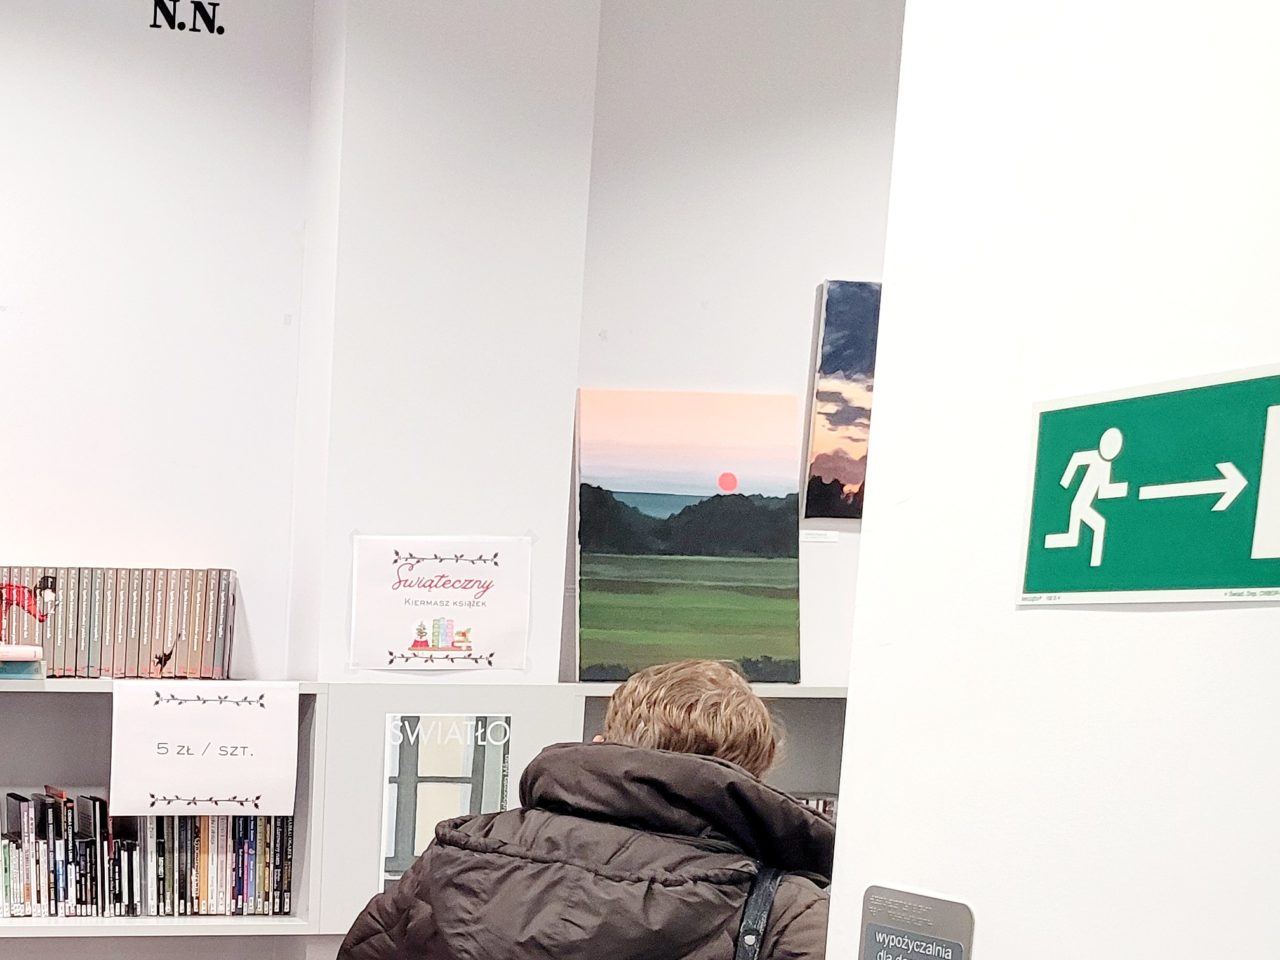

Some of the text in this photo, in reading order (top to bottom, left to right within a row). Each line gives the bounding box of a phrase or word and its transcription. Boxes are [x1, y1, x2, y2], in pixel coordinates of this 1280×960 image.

[156, 742, 169, 755] 5
[176, 745, 195, 756] ZŁ
[218, 745, 254, 757] SZT.
[875, 931, 952, 960] wypożyczalnia
